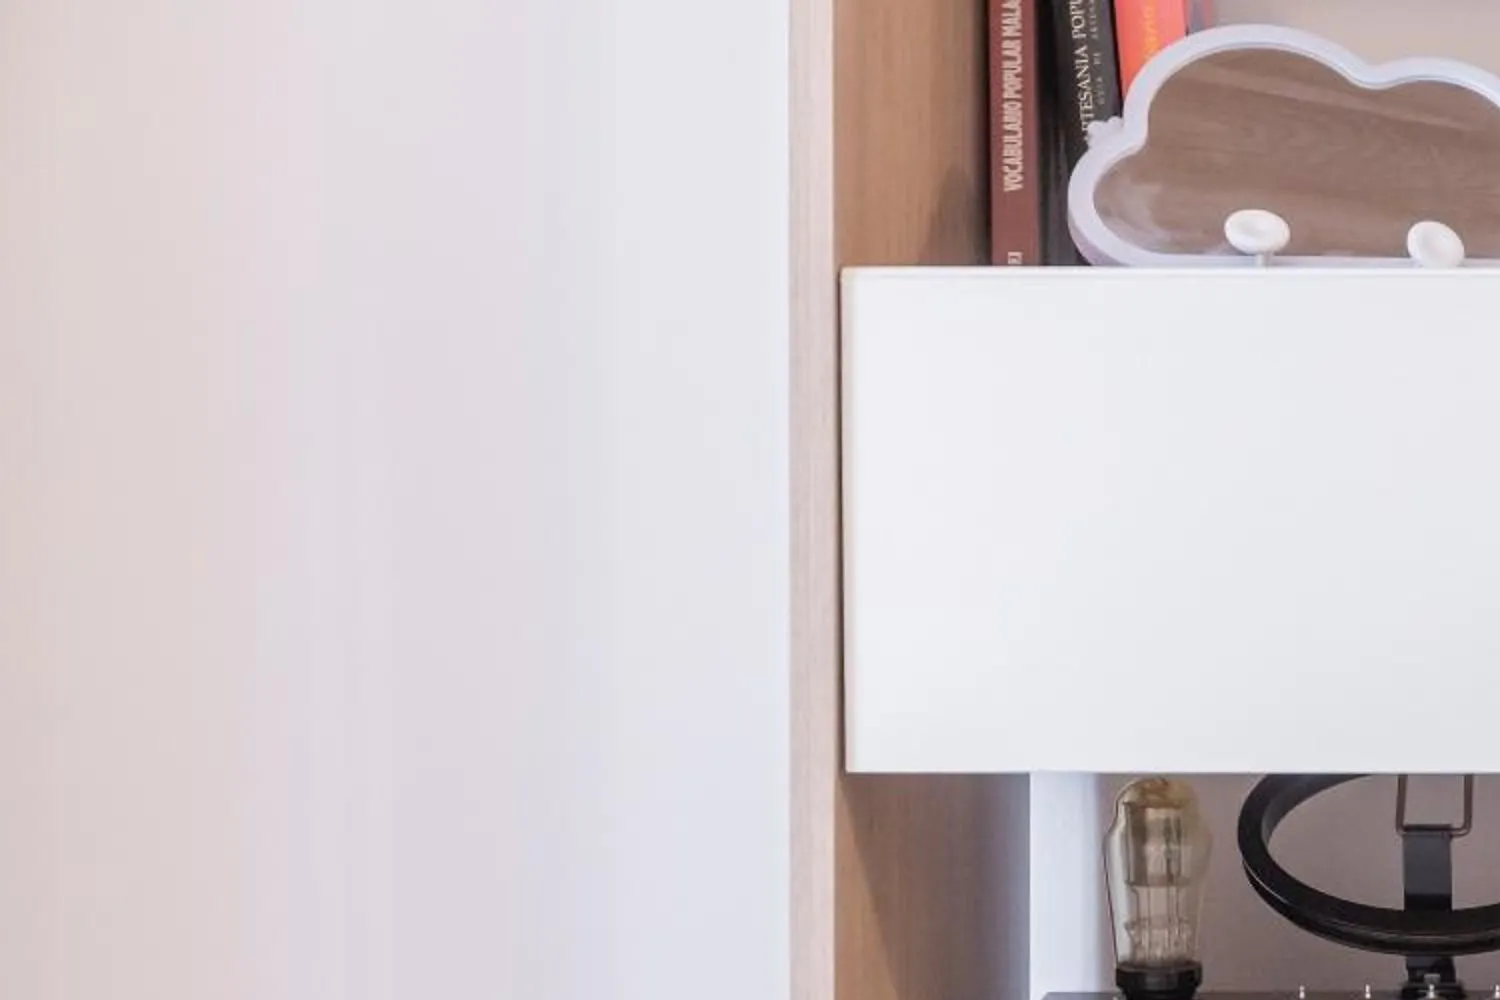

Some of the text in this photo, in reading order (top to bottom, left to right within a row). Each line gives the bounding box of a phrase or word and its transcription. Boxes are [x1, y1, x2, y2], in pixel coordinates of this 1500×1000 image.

[1002, 39, 1023, 98] POPULAR
[1074, 44, 1095, 142] TESANIA
[1003, 100, 1023, 192] VOCABULARIO
